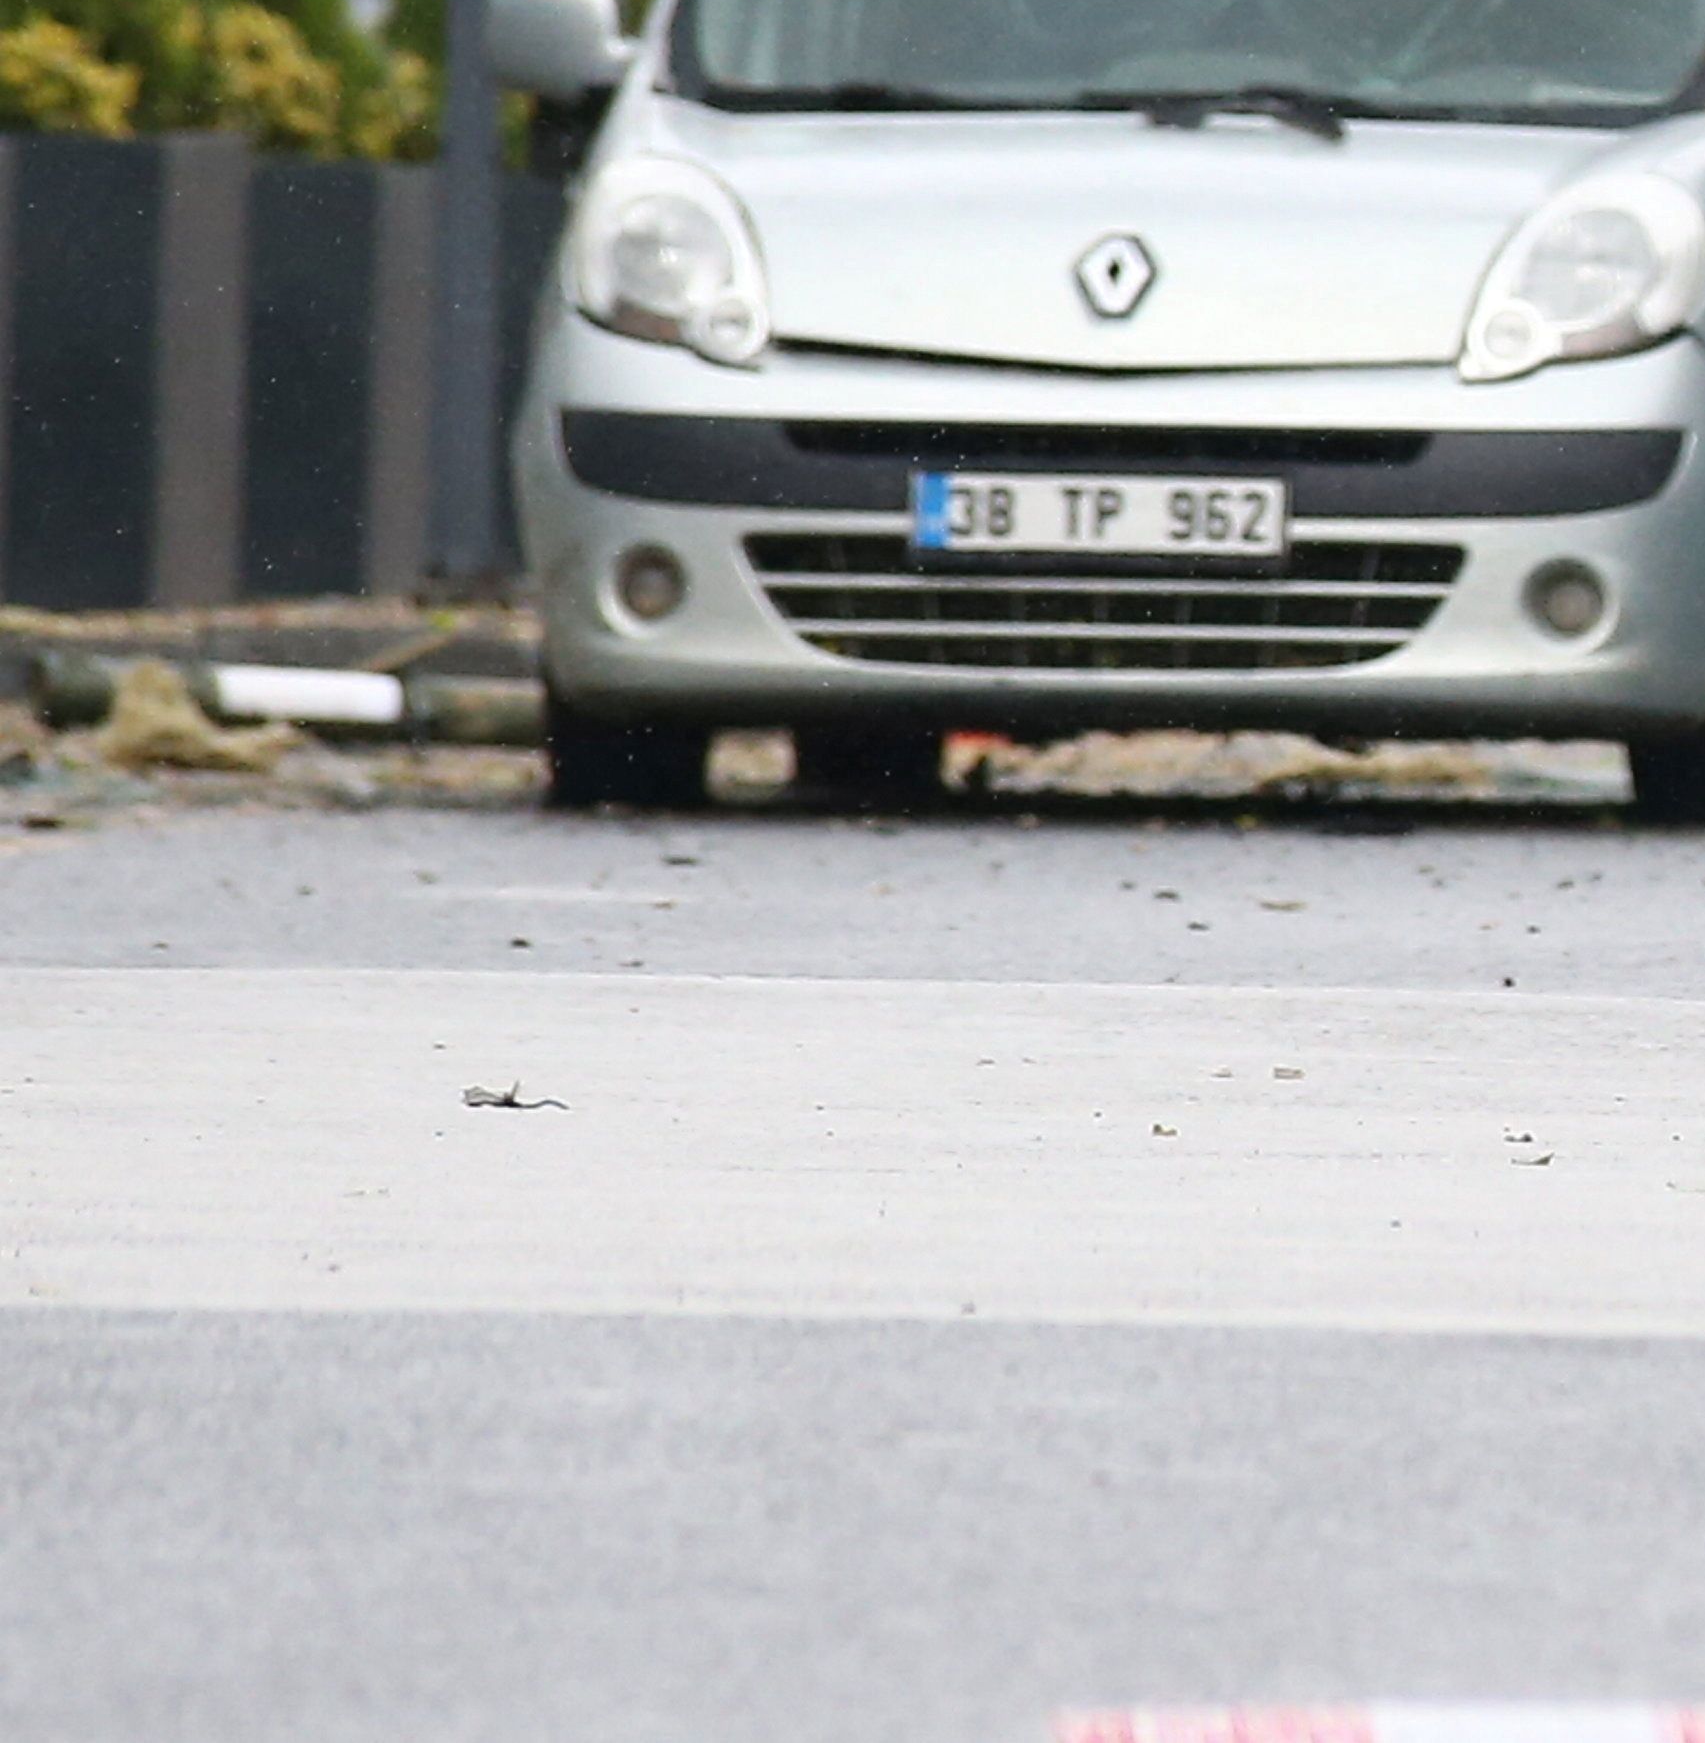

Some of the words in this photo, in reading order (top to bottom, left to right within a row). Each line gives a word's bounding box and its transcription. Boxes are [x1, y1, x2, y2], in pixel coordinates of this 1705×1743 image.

[949, 487, 1014, 537] 38
[1060, 488, 1123, 540] TP
[1168, 489, 1270, 543] 962
